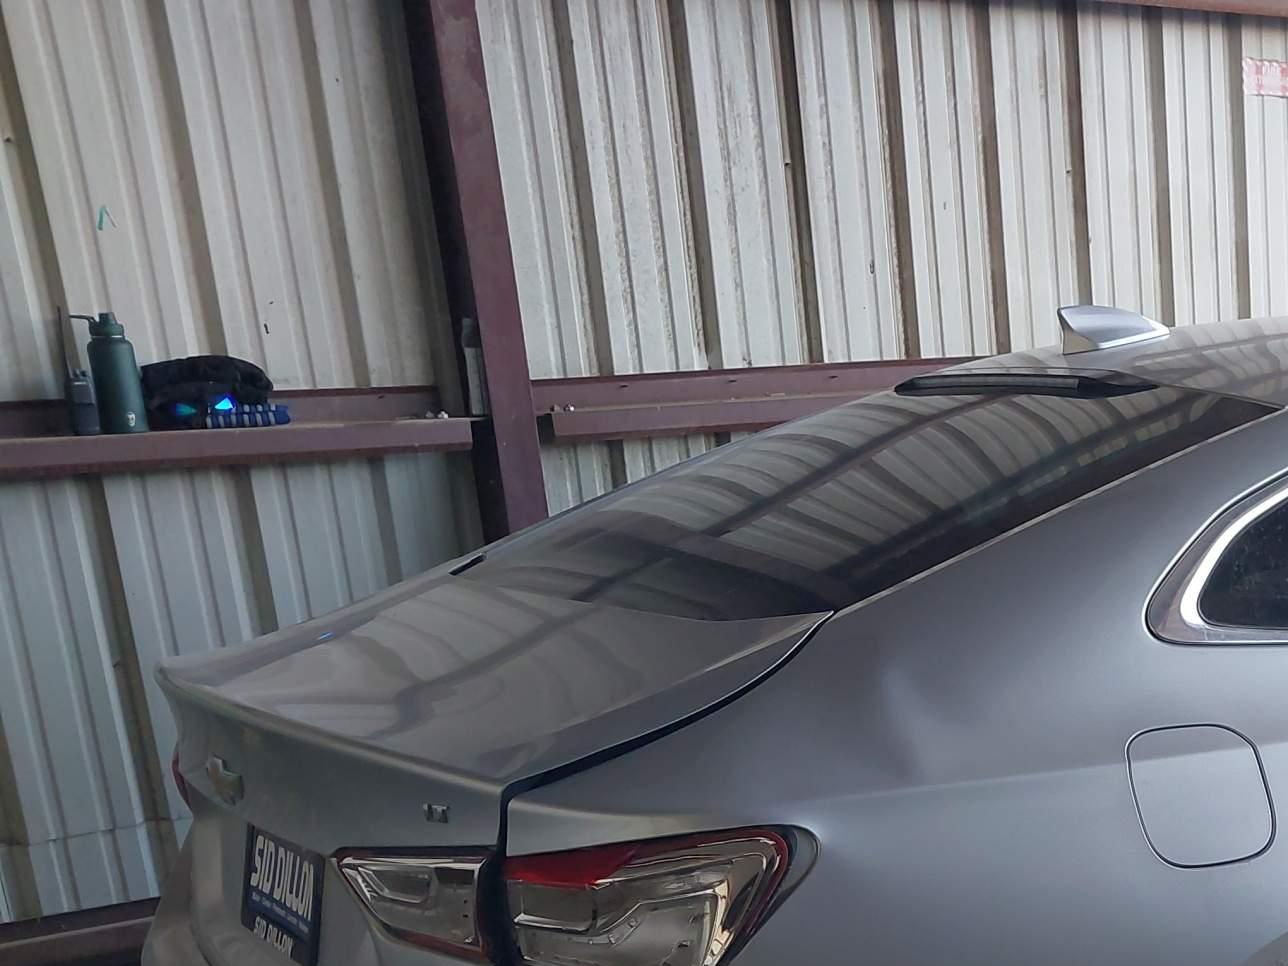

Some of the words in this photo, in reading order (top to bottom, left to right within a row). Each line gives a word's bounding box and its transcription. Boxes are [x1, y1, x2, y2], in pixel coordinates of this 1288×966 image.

[250, 835, 275, 894] SID
[272, 845, 314, 921] DILLON
[253, 915, 267, 939] SID
[266, 923, 293, 959] DILLON
